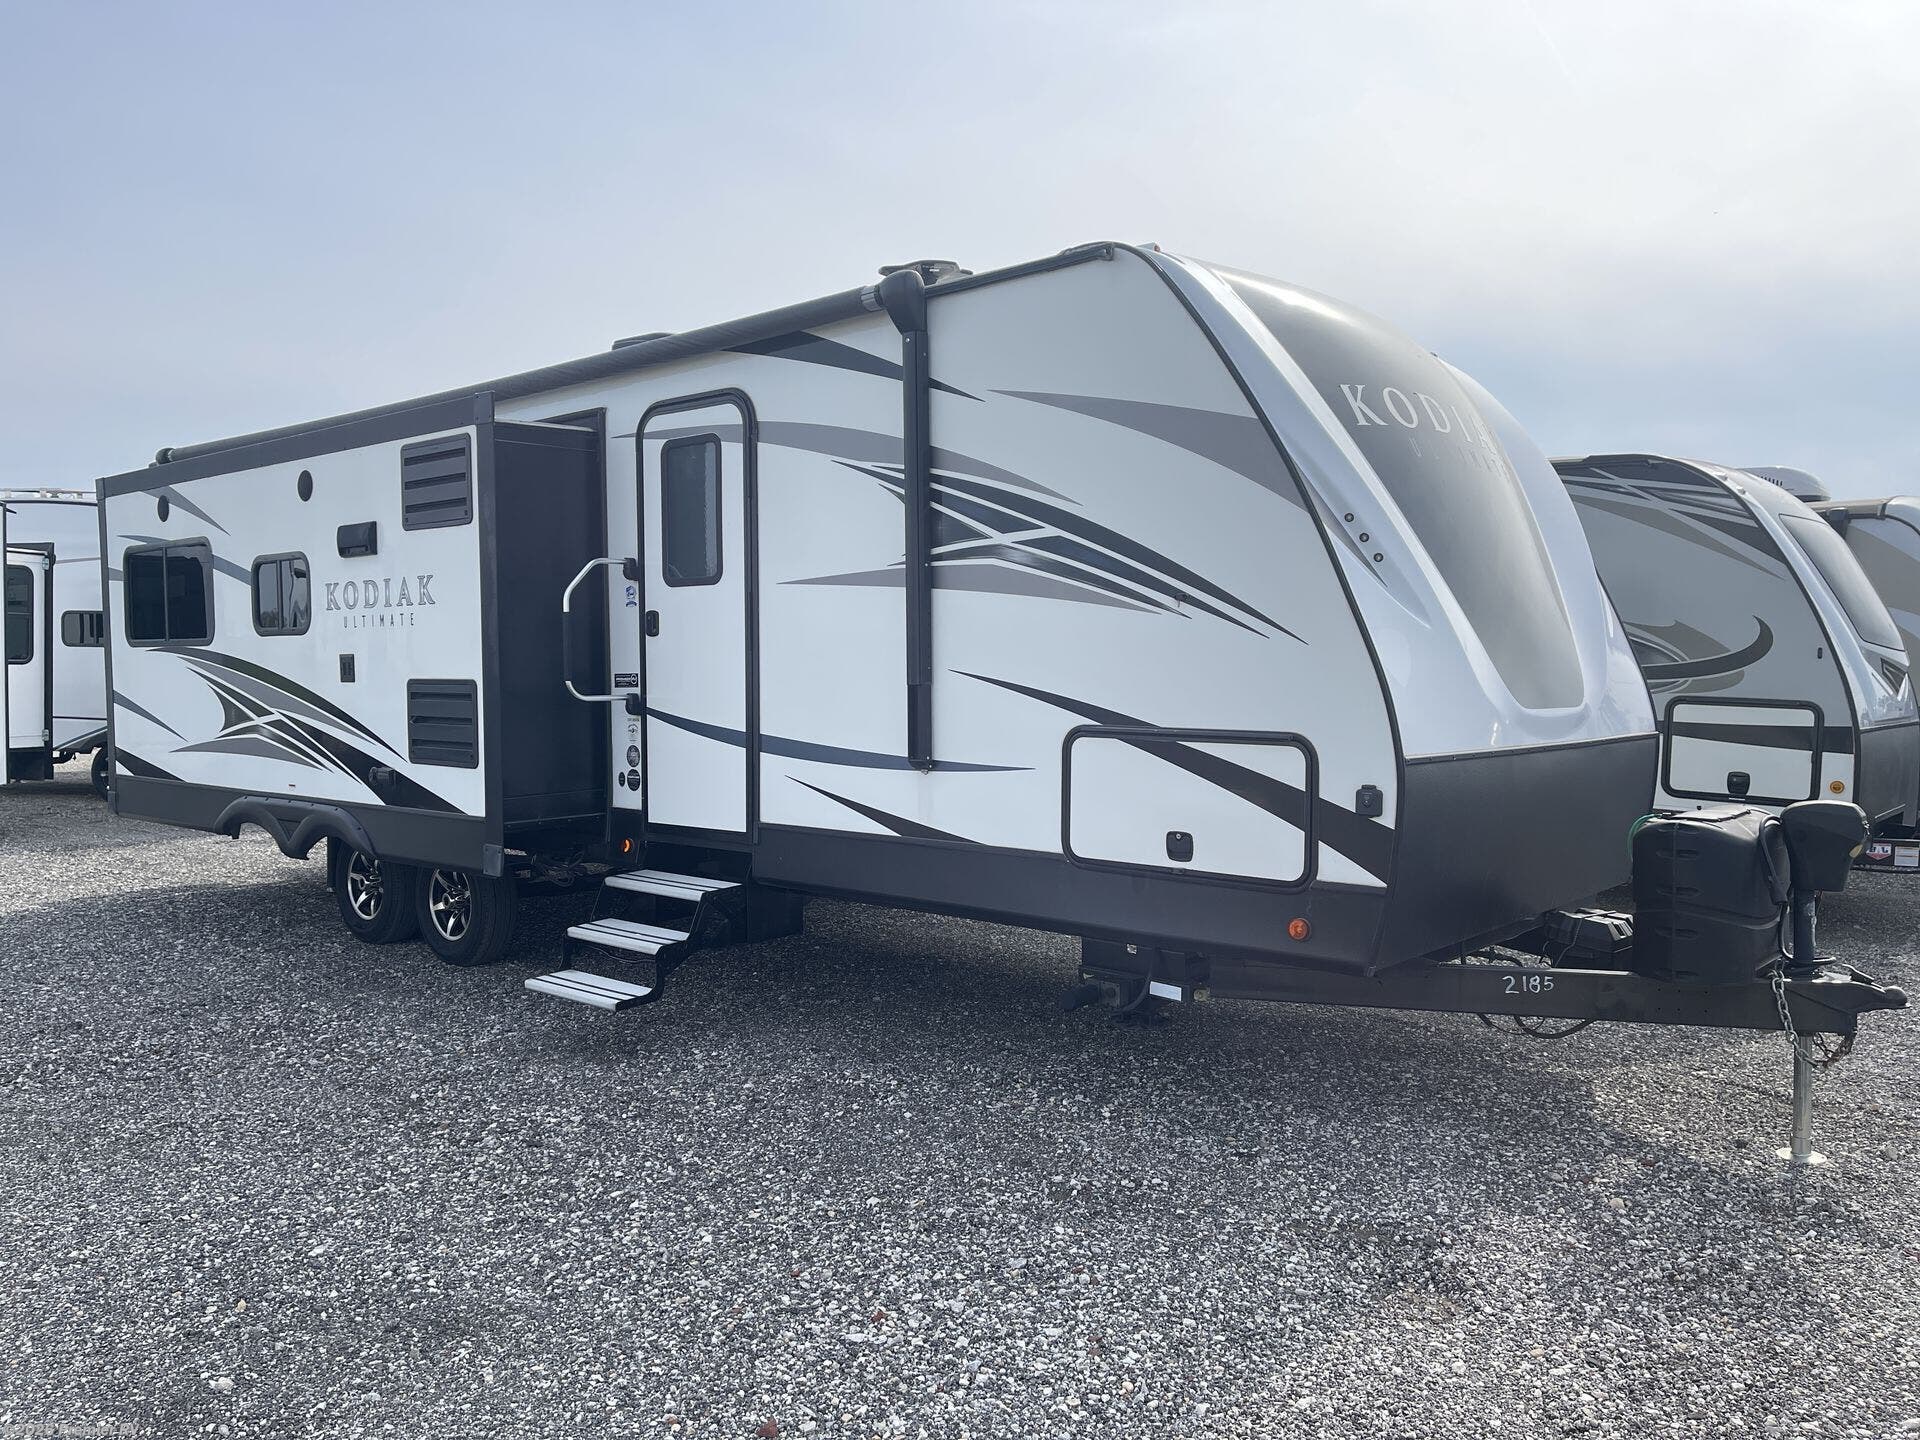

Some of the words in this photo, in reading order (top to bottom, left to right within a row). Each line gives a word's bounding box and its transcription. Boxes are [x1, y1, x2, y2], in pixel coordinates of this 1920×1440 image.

[325, 575, 436, 611] KODIAK
[343, 613, 415, 628] ULTIMATE
[1502, 975, 1555, 994] 2185
